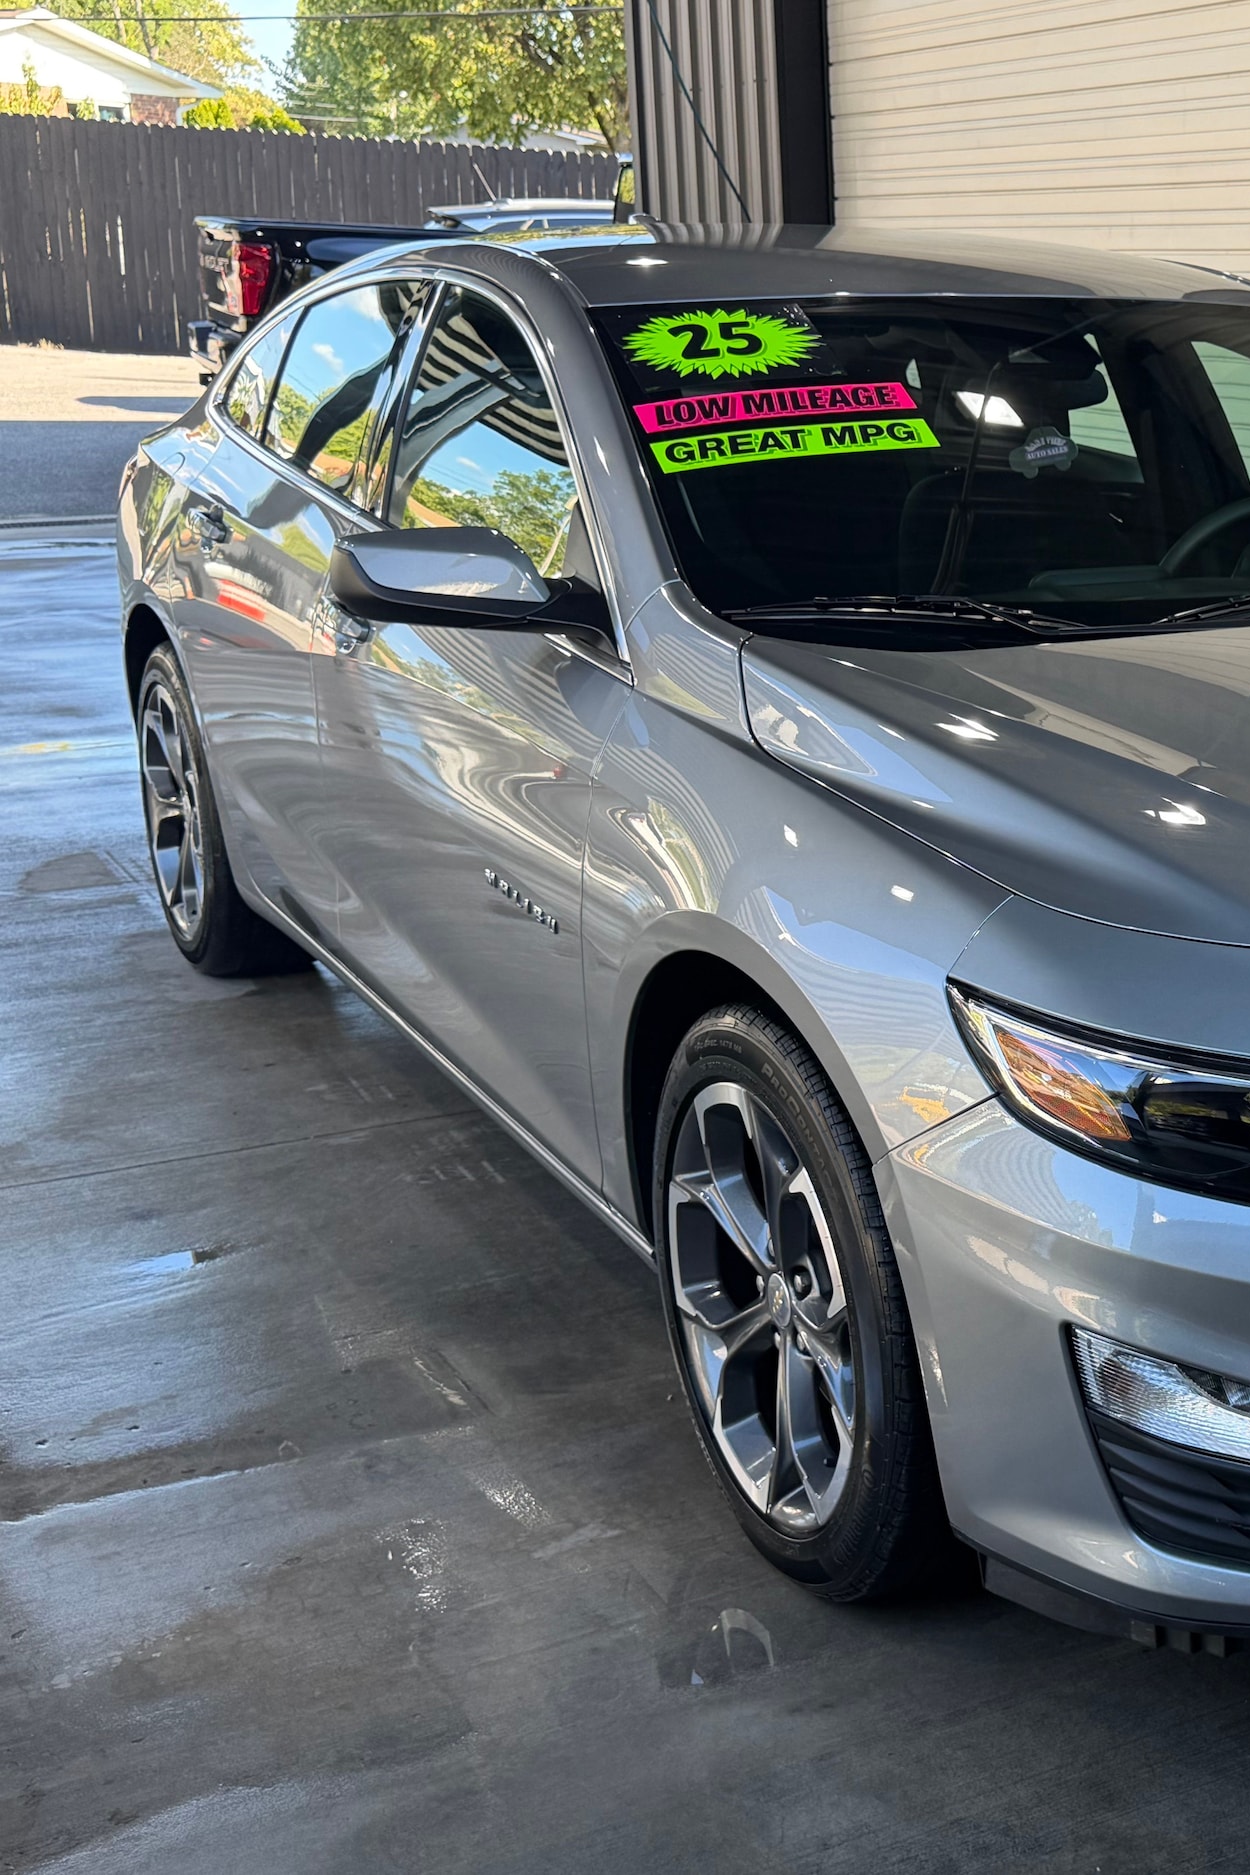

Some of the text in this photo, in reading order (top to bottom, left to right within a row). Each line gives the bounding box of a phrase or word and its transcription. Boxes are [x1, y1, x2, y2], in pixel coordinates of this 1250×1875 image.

[667, 320, 765, 360] 25
[655, 385, 900, 427] LOW MILEAGE
[664, 422, 918, 464] GREAT MPG
